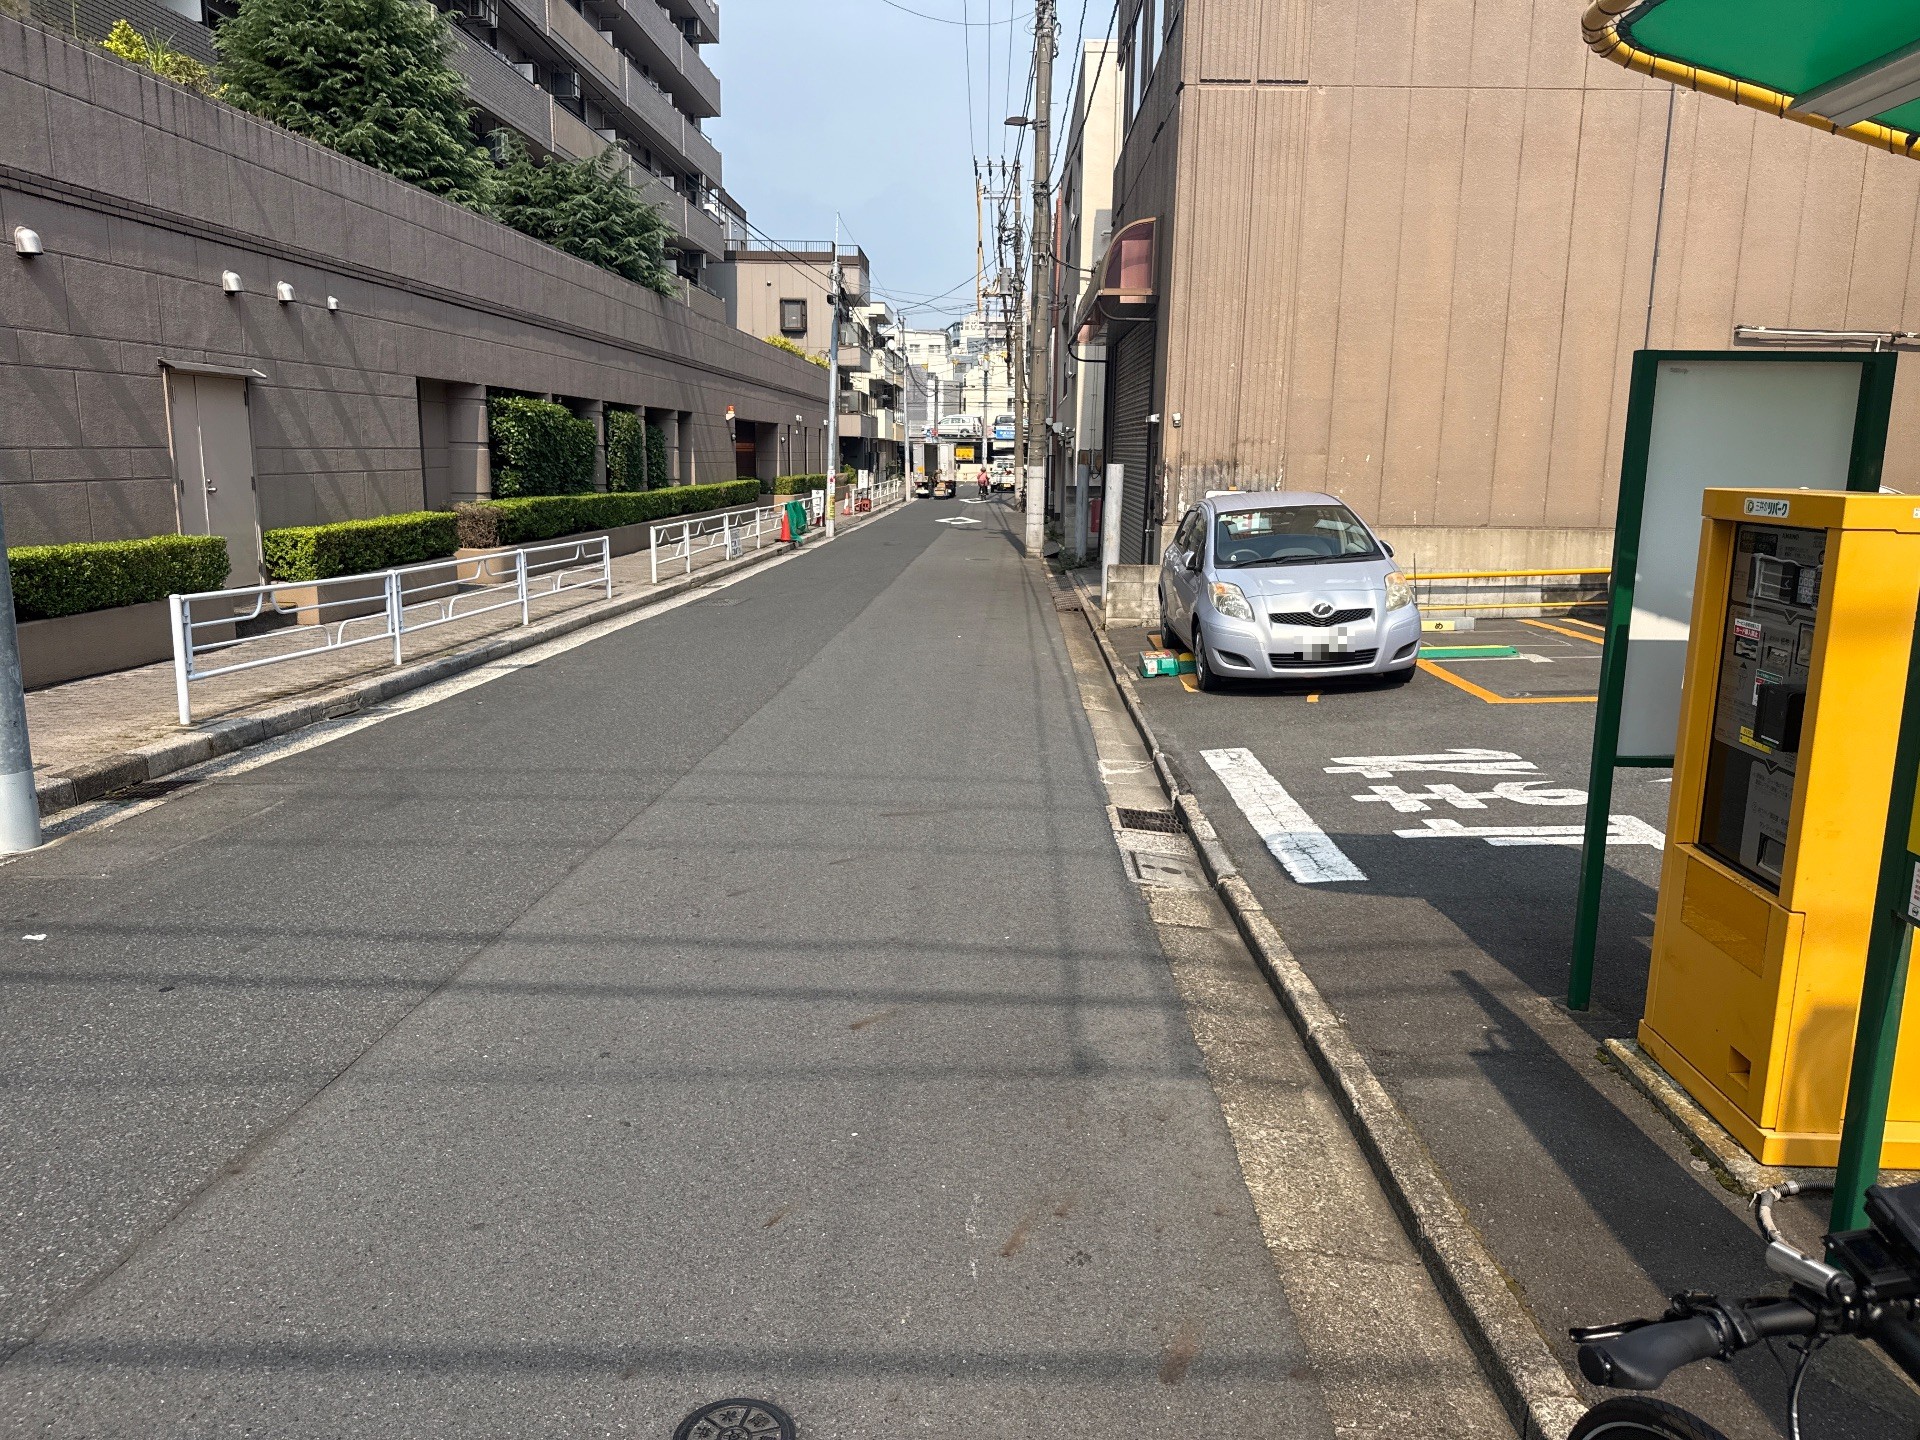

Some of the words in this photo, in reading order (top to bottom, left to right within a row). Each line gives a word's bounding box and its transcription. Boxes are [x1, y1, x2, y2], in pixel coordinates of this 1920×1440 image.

[1755, 501, 1788, 516] 三井のリパーク
[1434, 622, 1444, 630] め
